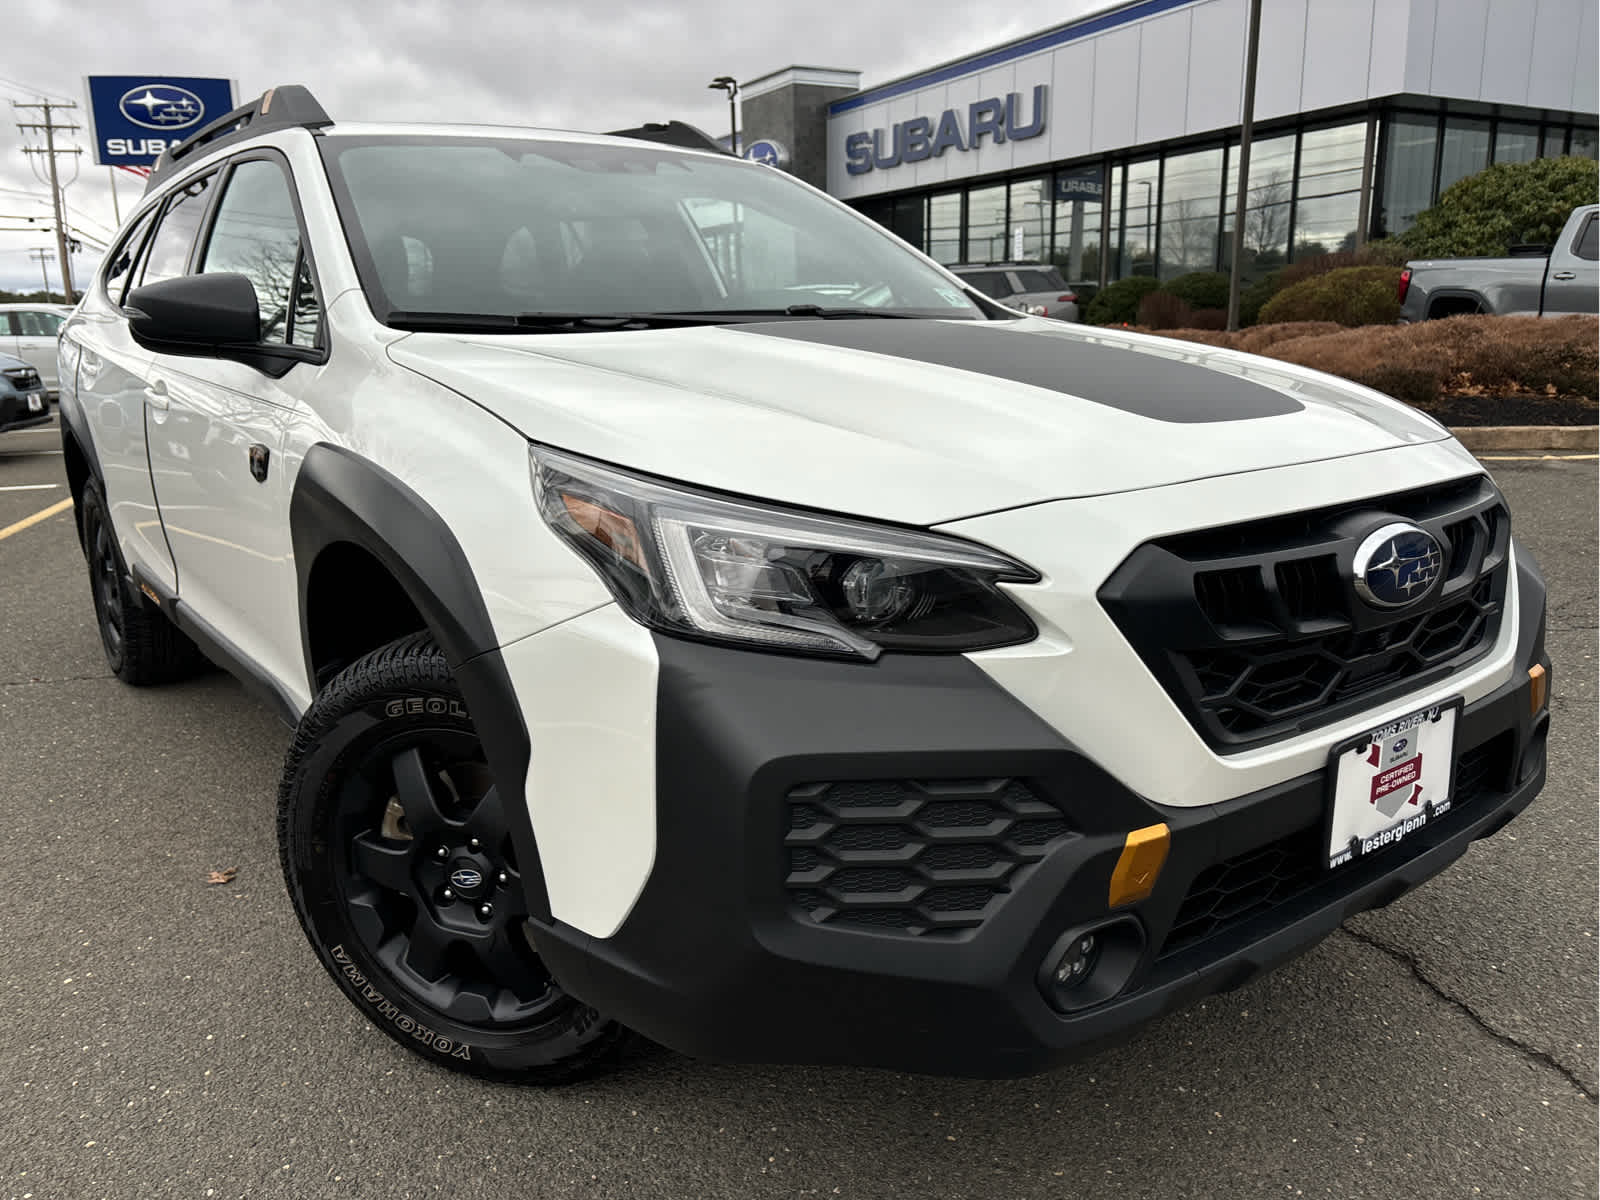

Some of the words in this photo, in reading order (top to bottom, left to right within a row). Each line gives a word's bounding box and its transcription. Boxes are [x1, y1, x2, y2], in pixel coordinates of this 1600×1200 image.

[845, 84, 1048, 175] SUBARU
[385, 697, 472, 719] GEOL
[1371, 726, 1397, 743] TOMS
[1427, 706, 1440, 721] NJ
[1376, 770, 1416, 795] PRE-OWNED
[1380, 763, 1414, 784] CERTIFIED
[331, 944, 471, 1060] YOKOHAMA
